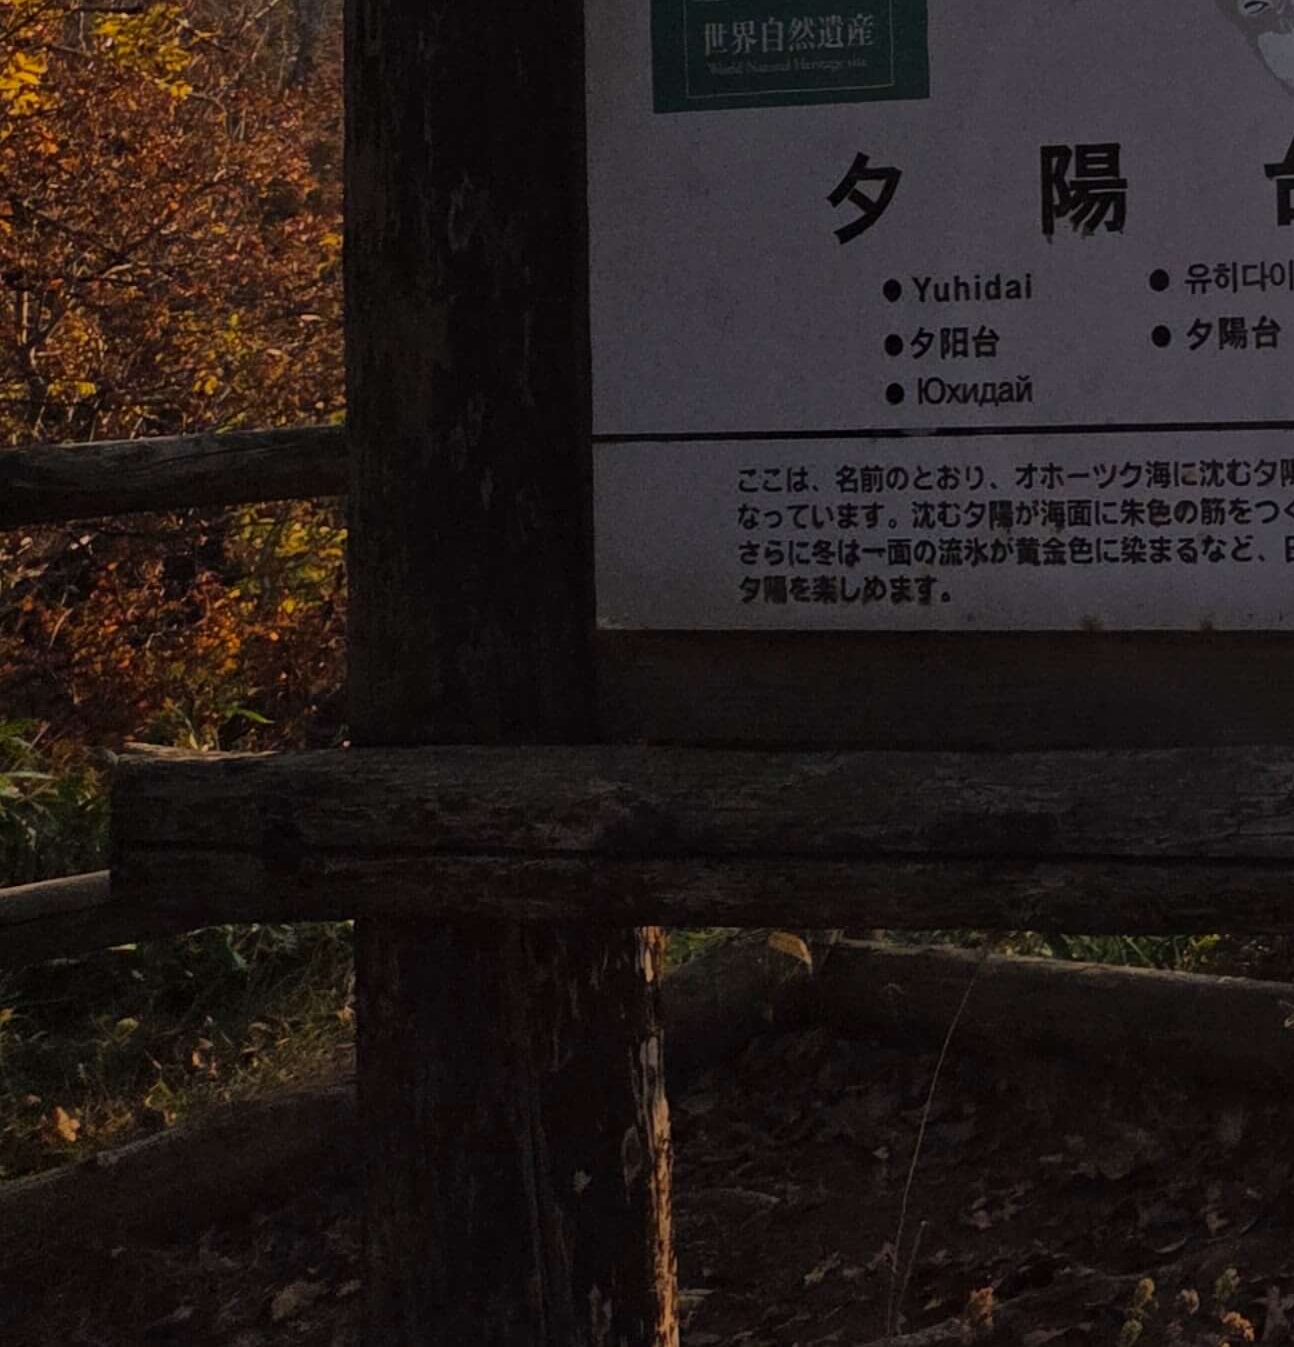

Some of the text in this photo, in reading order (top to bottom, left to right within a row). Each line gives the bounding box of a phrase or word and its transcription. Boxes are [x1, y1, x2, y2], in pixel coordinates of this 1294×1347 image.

[704, 13, 875, 57] 世界自然遺産
[911, 272, 1033, 303] Yuhidai
[909, 325, 1001, 360] 夕阳台
[1185, 315, 1283, 351] 夕陽台
[916, 375, 1034, 407] Юхидай
[738, 575, 953, 606] 夕陽を楽しめます。
